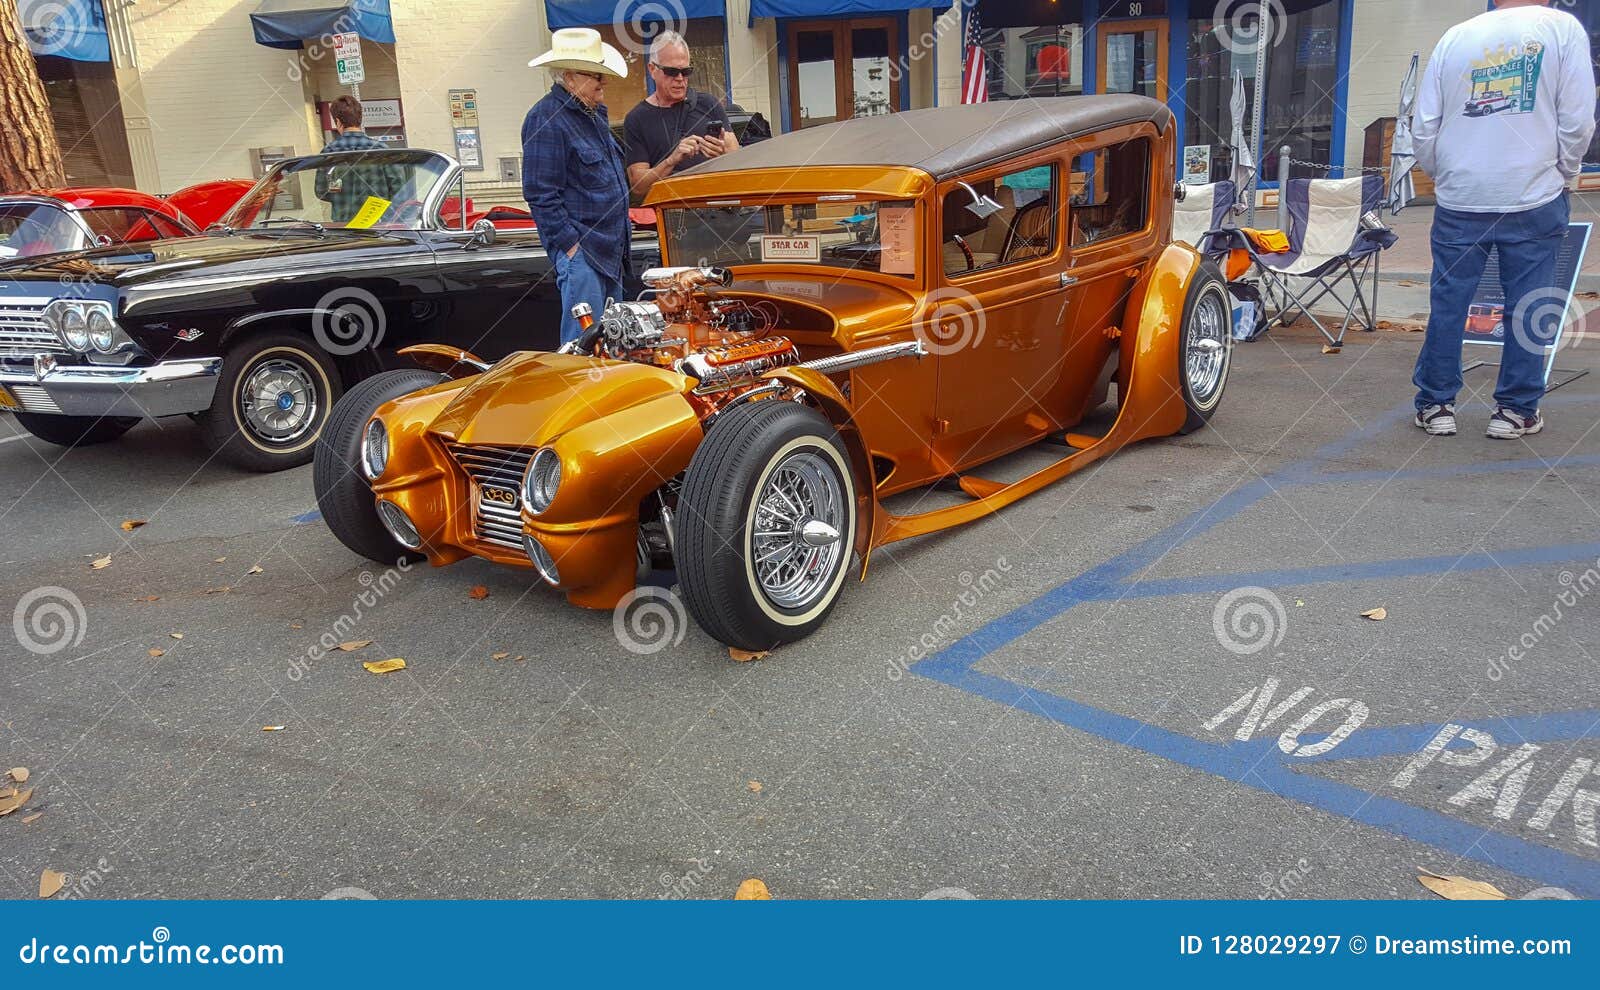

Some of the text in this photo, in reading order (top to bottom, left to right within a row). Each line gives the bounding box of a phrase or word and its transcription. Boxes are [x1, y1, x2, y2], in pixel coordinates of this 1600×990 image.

[1129, 2, 1141, 16] 80
[1525, 55, 1538, 100] MOTEL
[364, 105, 393, 113] ITIZENS
[771, 241, 809, 249] STAR CAR
[1201, 677, 1370, 757] NO
